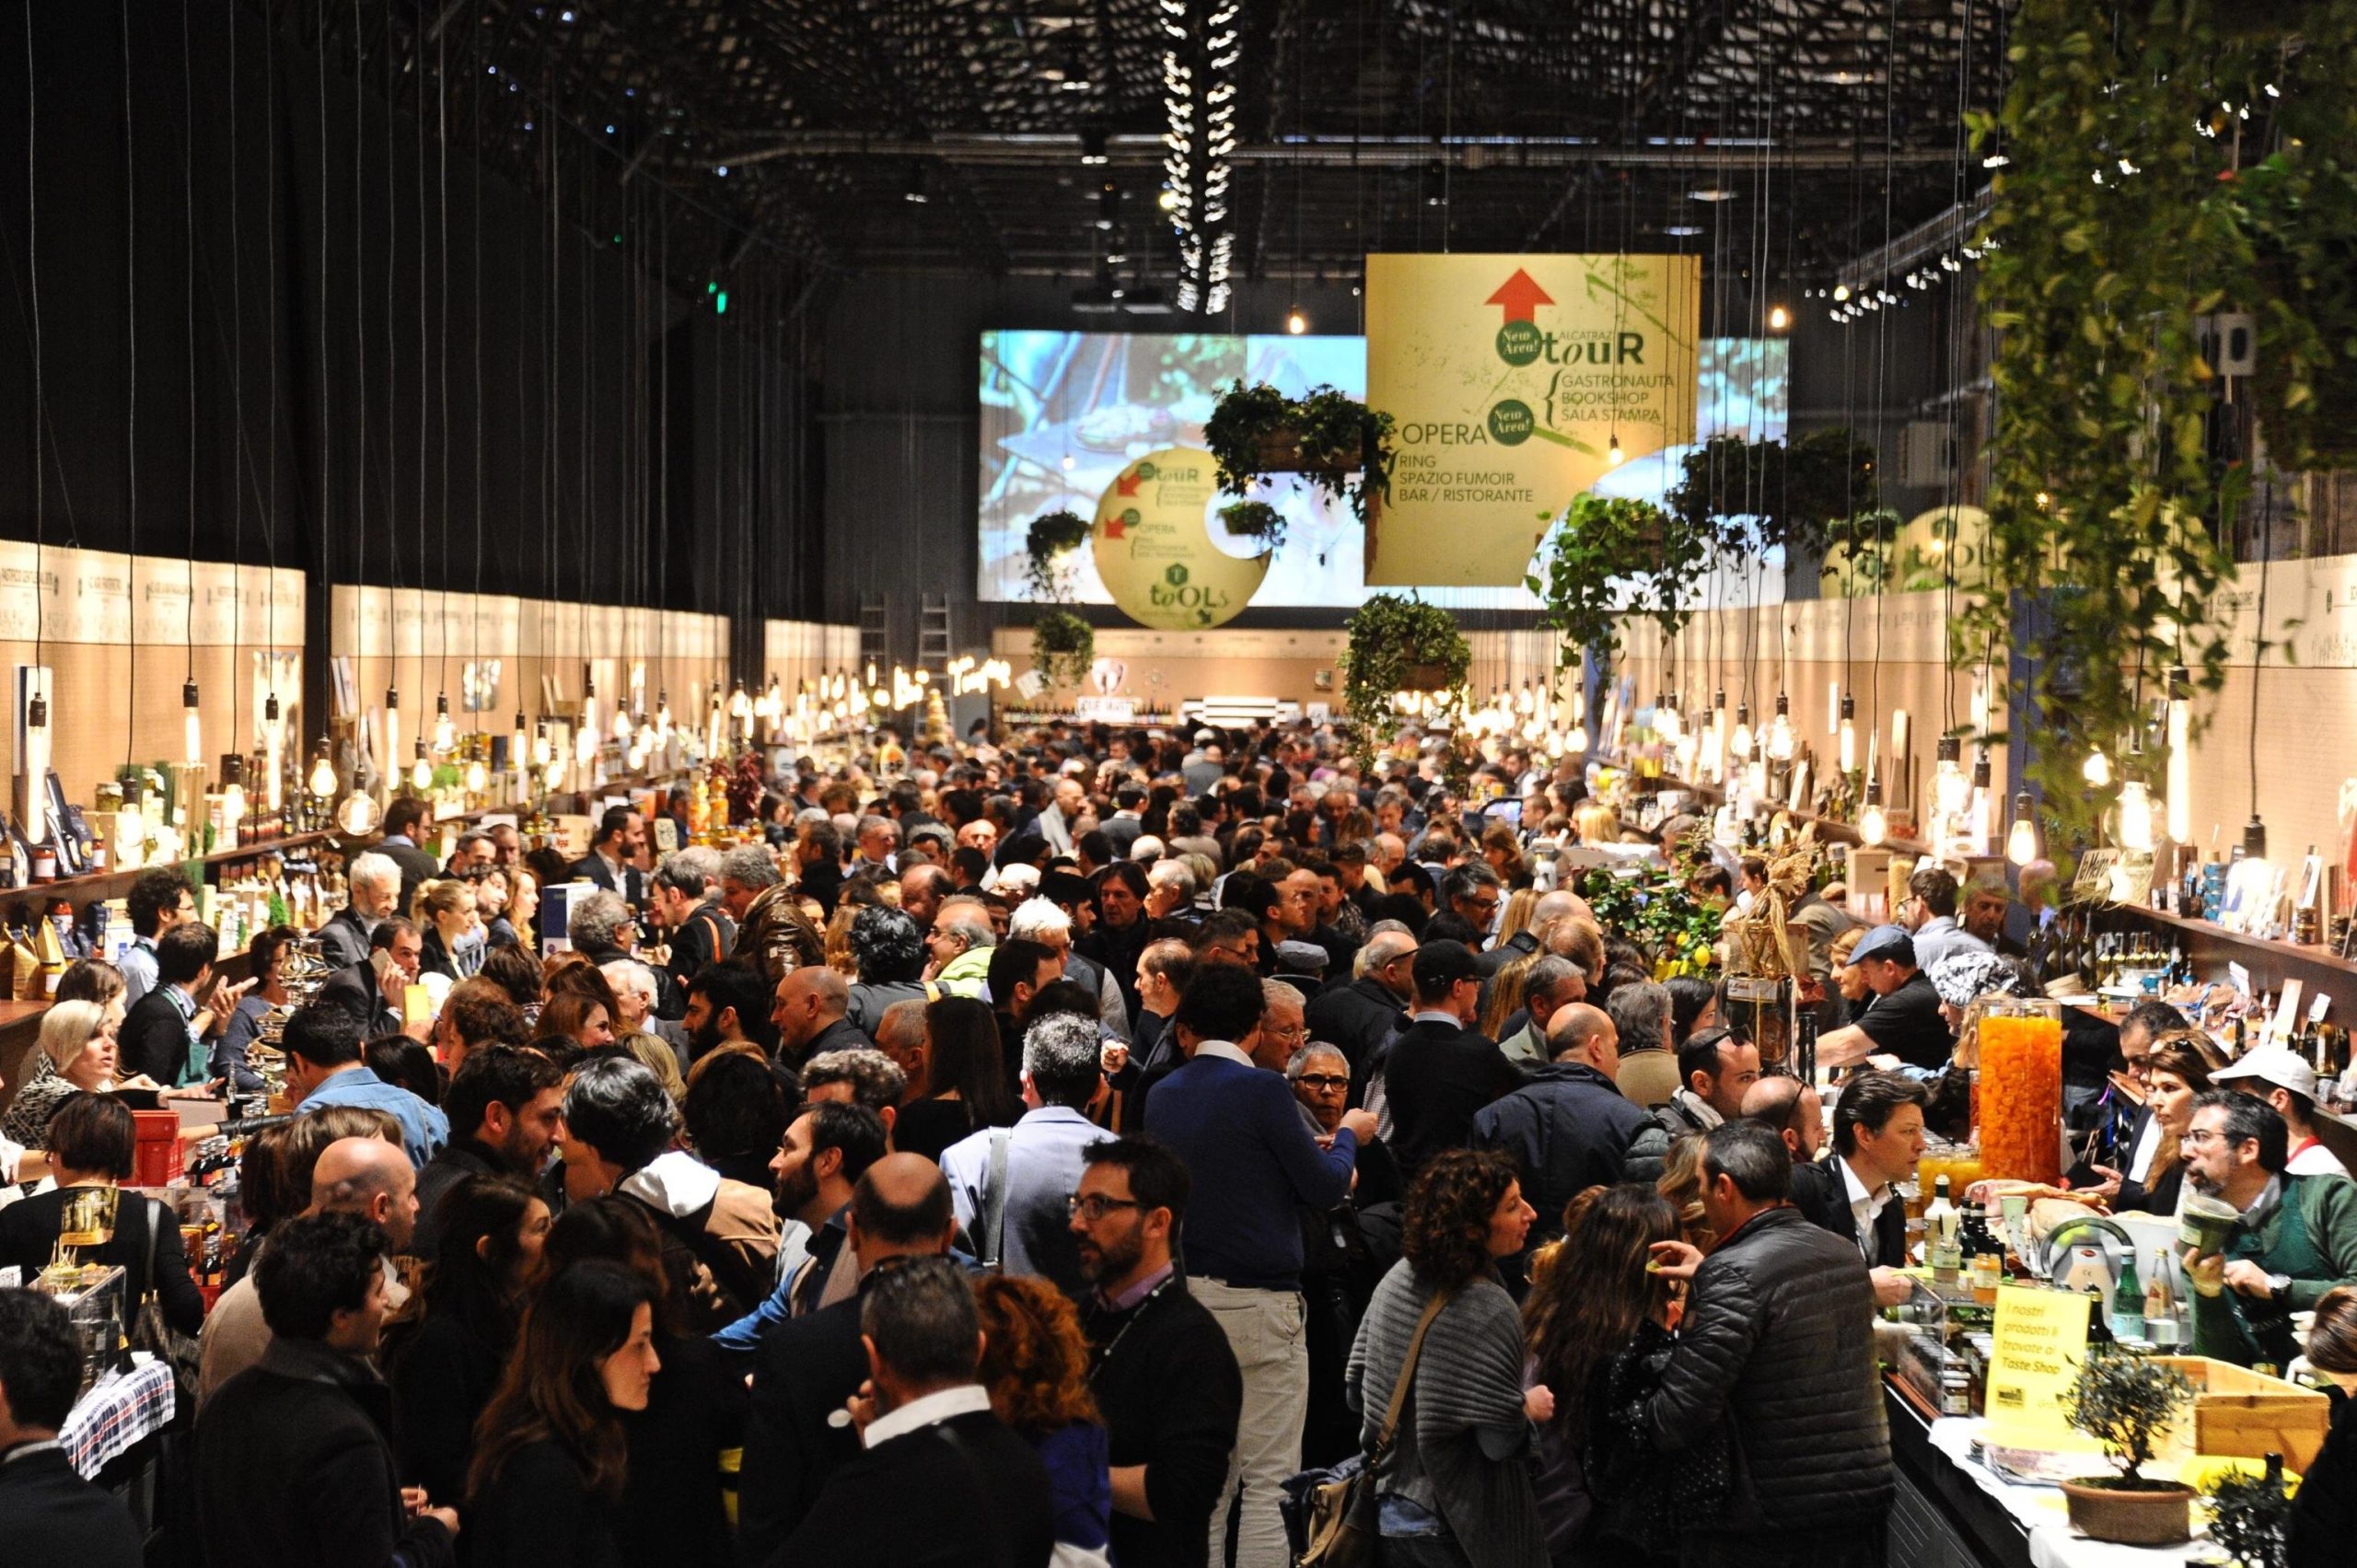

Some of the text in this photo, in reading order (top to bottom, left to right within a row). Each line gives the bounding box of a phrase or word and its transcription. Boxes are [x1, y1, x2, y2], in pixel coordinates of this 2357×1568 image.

[1502, 331, 1530, 342] New
[1559, 331, 1613, 341] ALCATRAZ
[1502, 339, 1539, 355] Area!
[1541, 331, 1644, 366] touR
[1562, 375, 1674, 388] GASTRONAUTA
[1562, 392, 1649, 405] BOOKSHOP
[1494, 410, 1523, 421] New
[1562, 409, 1661, 422] SALA STAMPA
[1494, 417, 1531, 435] Area!
[1402, 424, 1488, 445] OPERA
[1399, 455, 1436, 469] RING
[1399, 472, 1515, 485] SPAZIO FUMOIR
[1399, 489, 1428, 502] BAR
[1443, 489, 1534, 502] RISTORANTE
[1139, 524, 1177, 534] OPERA
[2012, 1305, 2045, 1318] nostri
[2003, 1323, 2049, 1337] prodotti
[2003, 1341, 2043, 1354] trovate
[2003, 1356, 2061, 1375] Taste Shop
